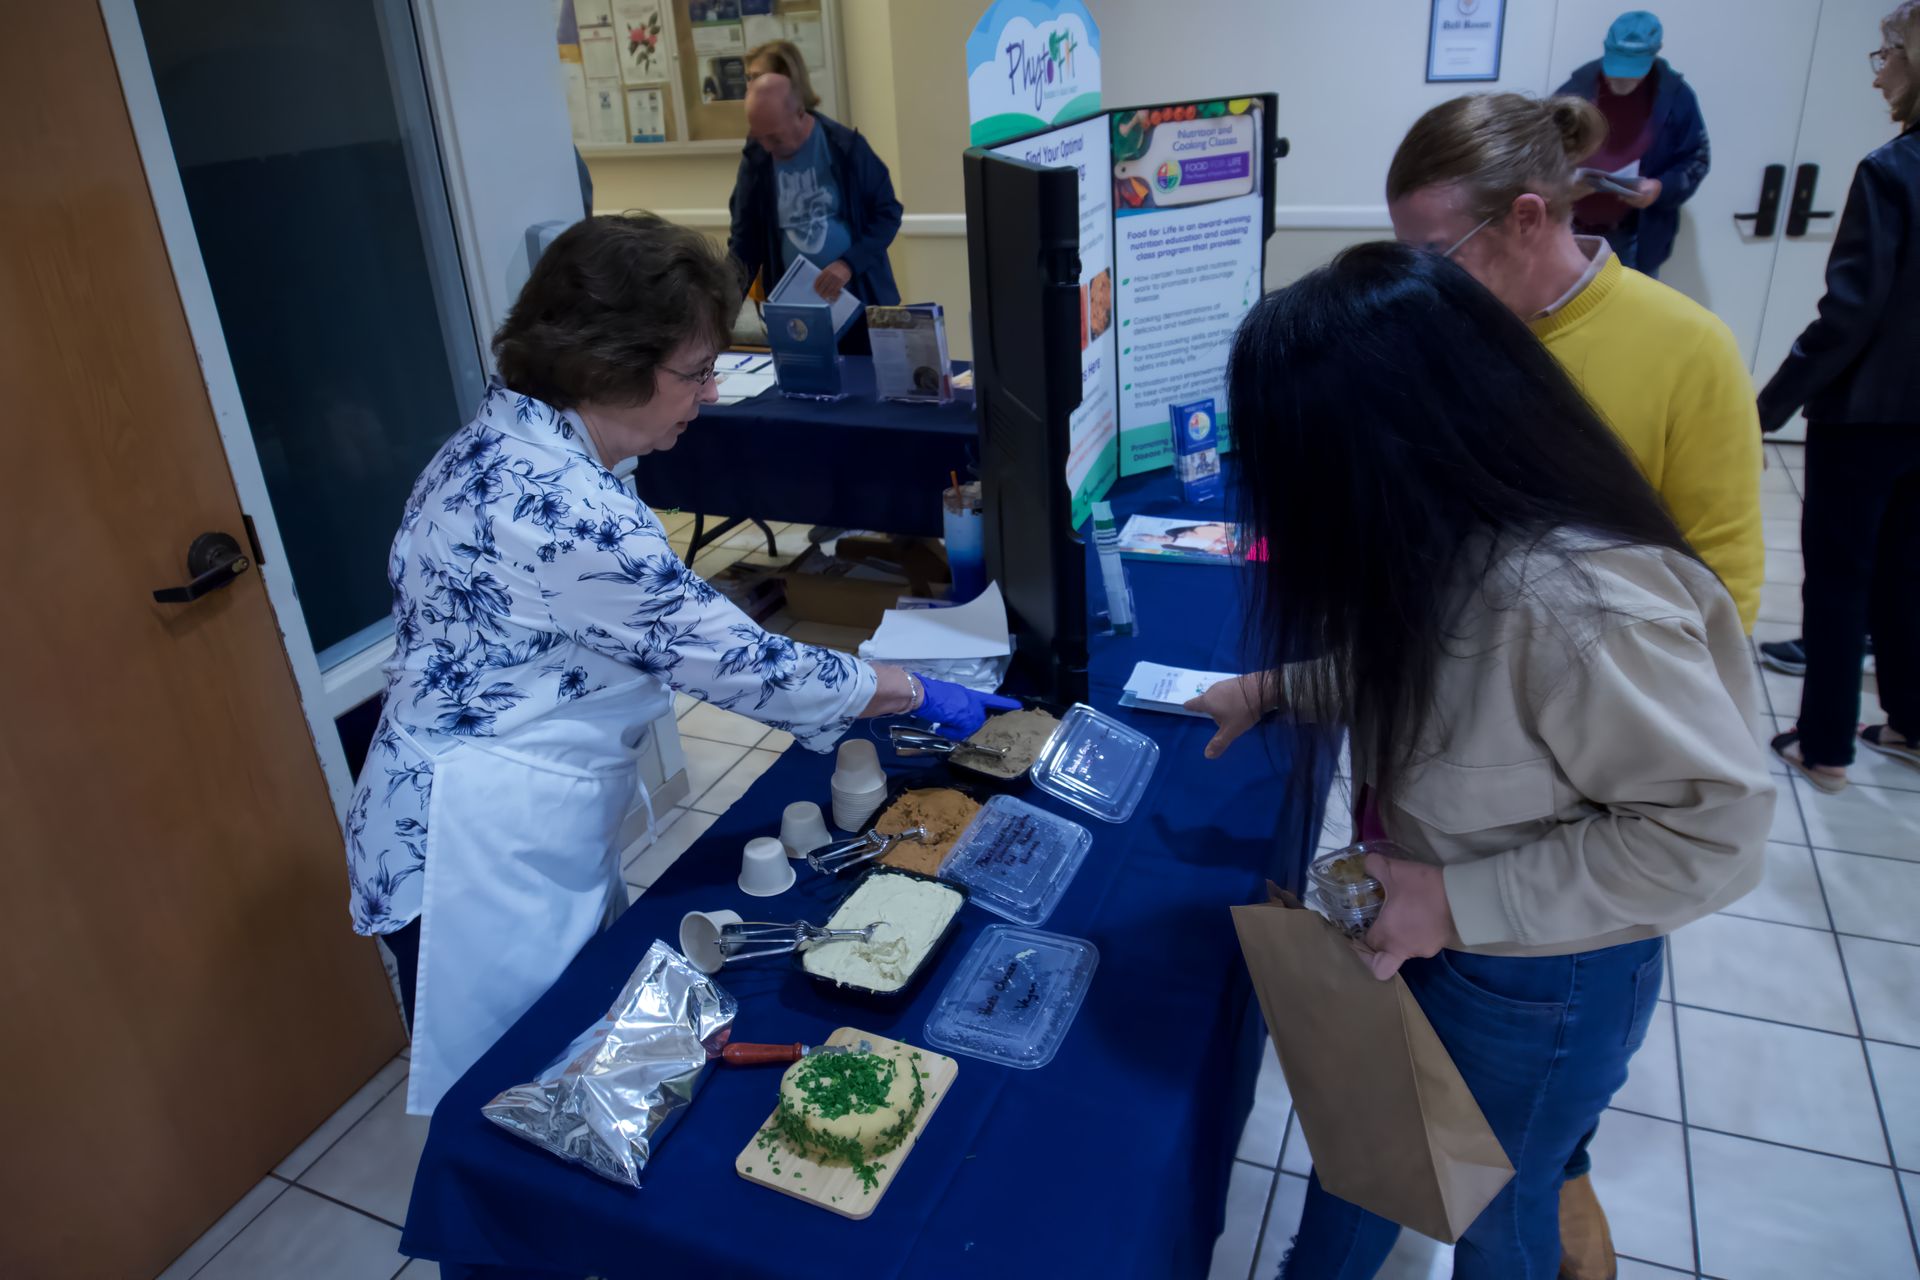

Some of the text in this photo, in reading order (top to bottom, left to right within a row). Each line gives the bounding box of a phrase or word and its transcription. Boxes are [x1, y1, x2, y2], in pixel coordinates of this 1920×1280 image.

[1177, 124, 1232, 140] Nutrition and
[1043, 145, 1059, 163] Your
[1061, 133, 1084, 159] Optimal
[1172, 135, 1238, 152] Cooking Classes
[1184, 161, 1209, 173] FOOD
[1127, 230, 1147, 240] Food
[1149, 228, 1160, 237] for
[1162, 225, 1177, 235] Life
[1186, 223, 1197, 231] an
[1198, 215, 1252, 230] award-winning
[1130, 226, 1249, 251] nutrition education and cooking
[1136, 251, 1156, 261] class
[1157, 245, 1192, 259] program
[1192, 242, 1208, 251] that
